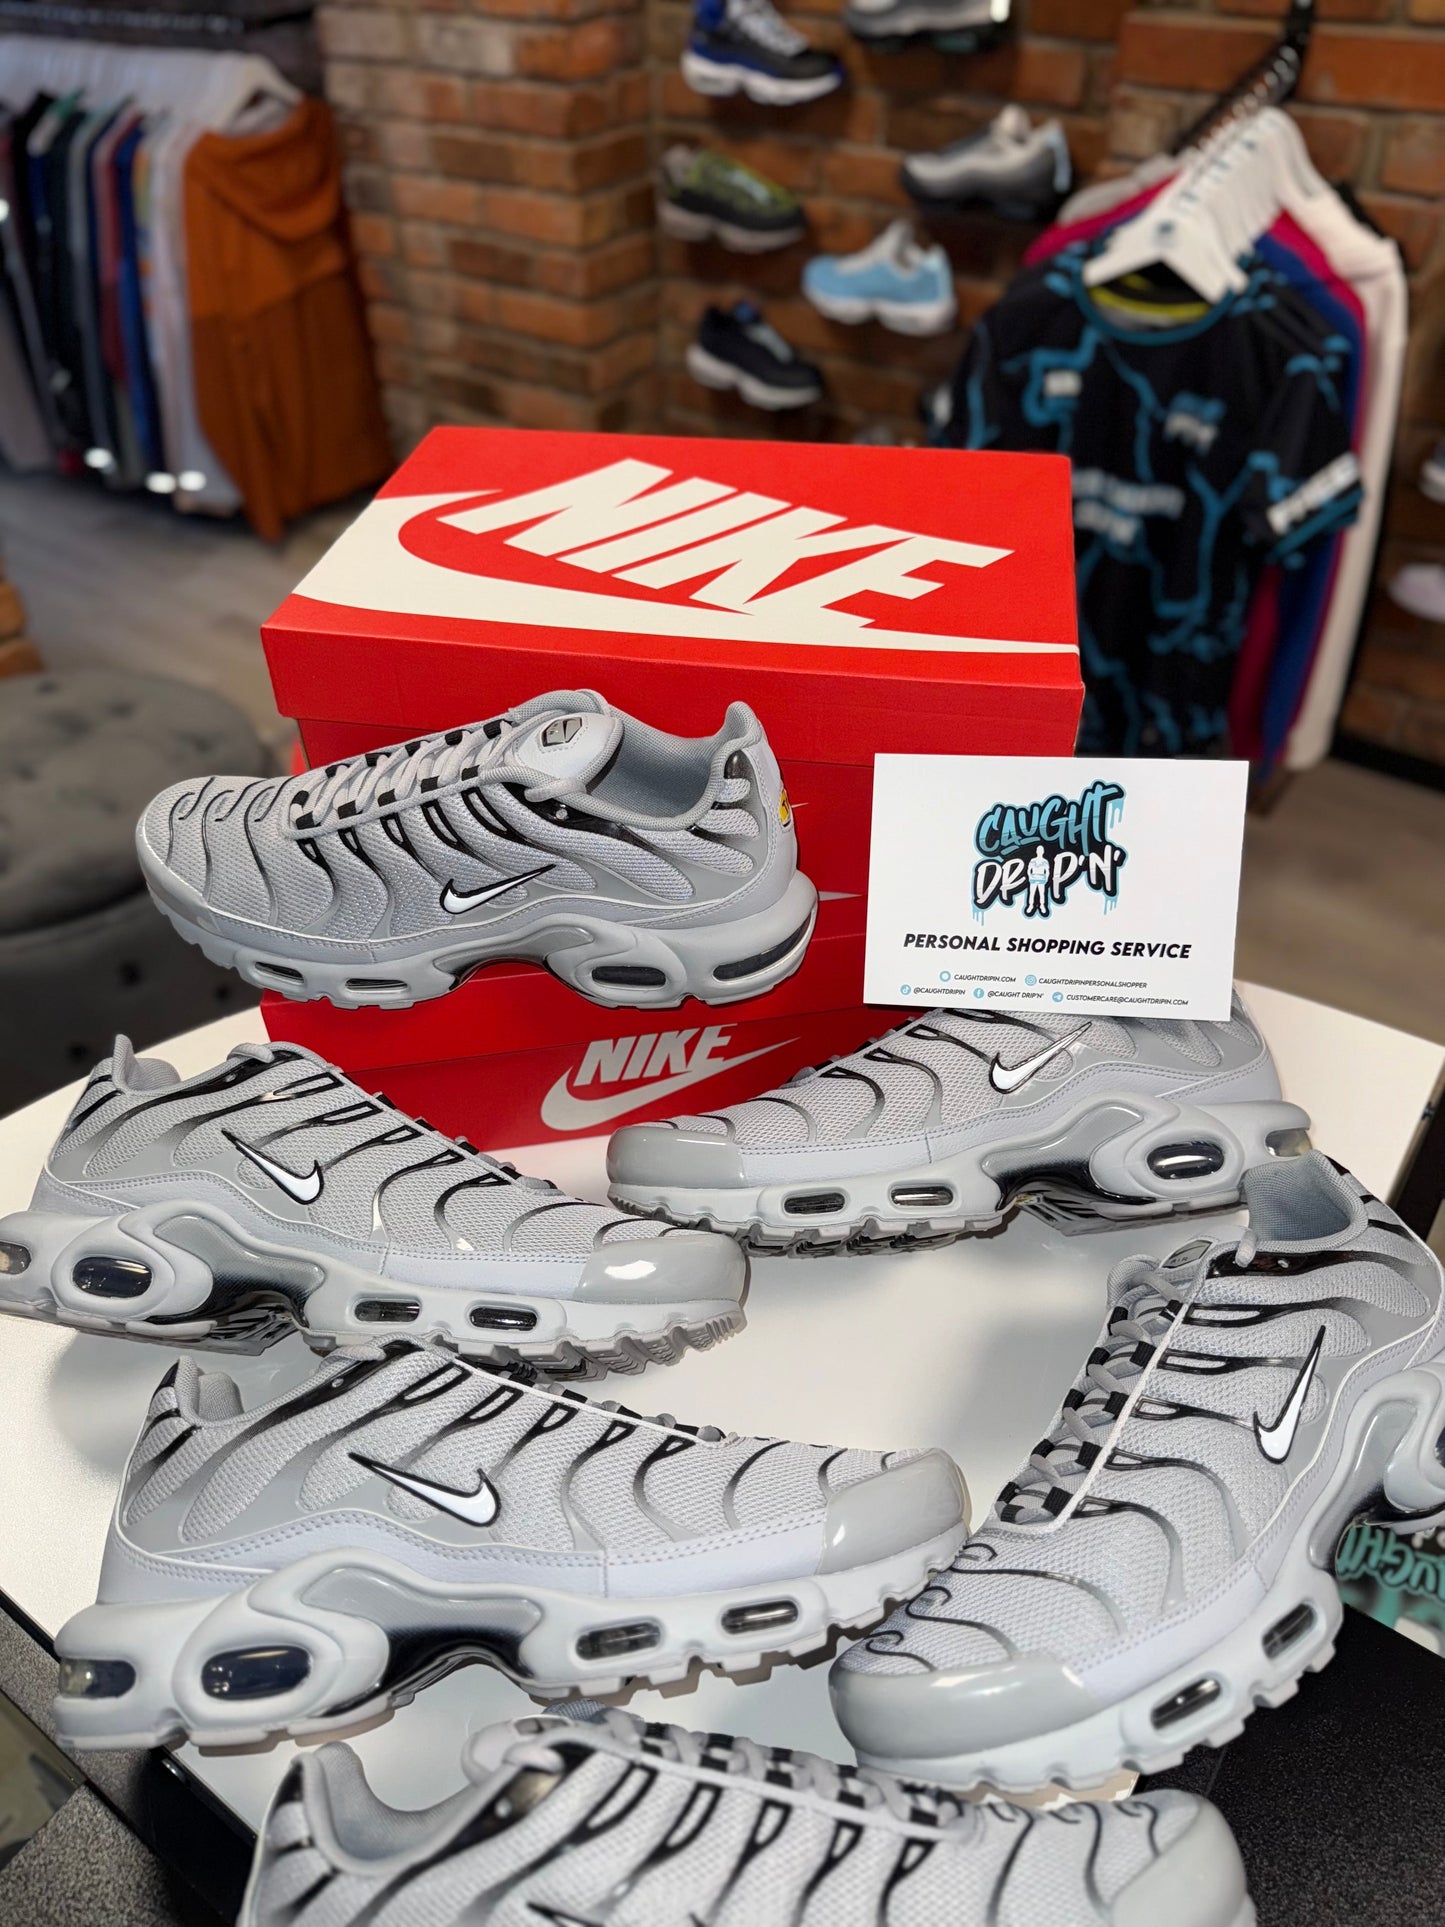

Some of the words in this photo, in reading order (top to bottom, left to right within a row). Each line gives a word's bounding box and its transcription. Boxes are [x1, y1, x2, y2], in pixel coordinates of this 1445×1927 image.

[436, 457, 1015, 629] NIKE
[977, 782, 1121, 857] CAUGHT
[903, 933, 1001, 951] PERSONAL
[1006, 937, 1106, 956] SHOPPING
[1110, 941, 1193, 959] SERVICE
[953, 974, 1017, 983] CAUGHTDRIPIN.COM
[1038, 977, 1148, 989] CAUGHTDRIPINPERSONALSHOPPER
[913, 986, 966, 996] @CAUGHTDRIPIN
[987, 990, 1021, 998] @CAUGHT
[1066, 994, 1189, 1006] CUSTOMERCARE@CAUGHTDRIPIN.COM
[572, 1022, 739, 1087] NIKE
